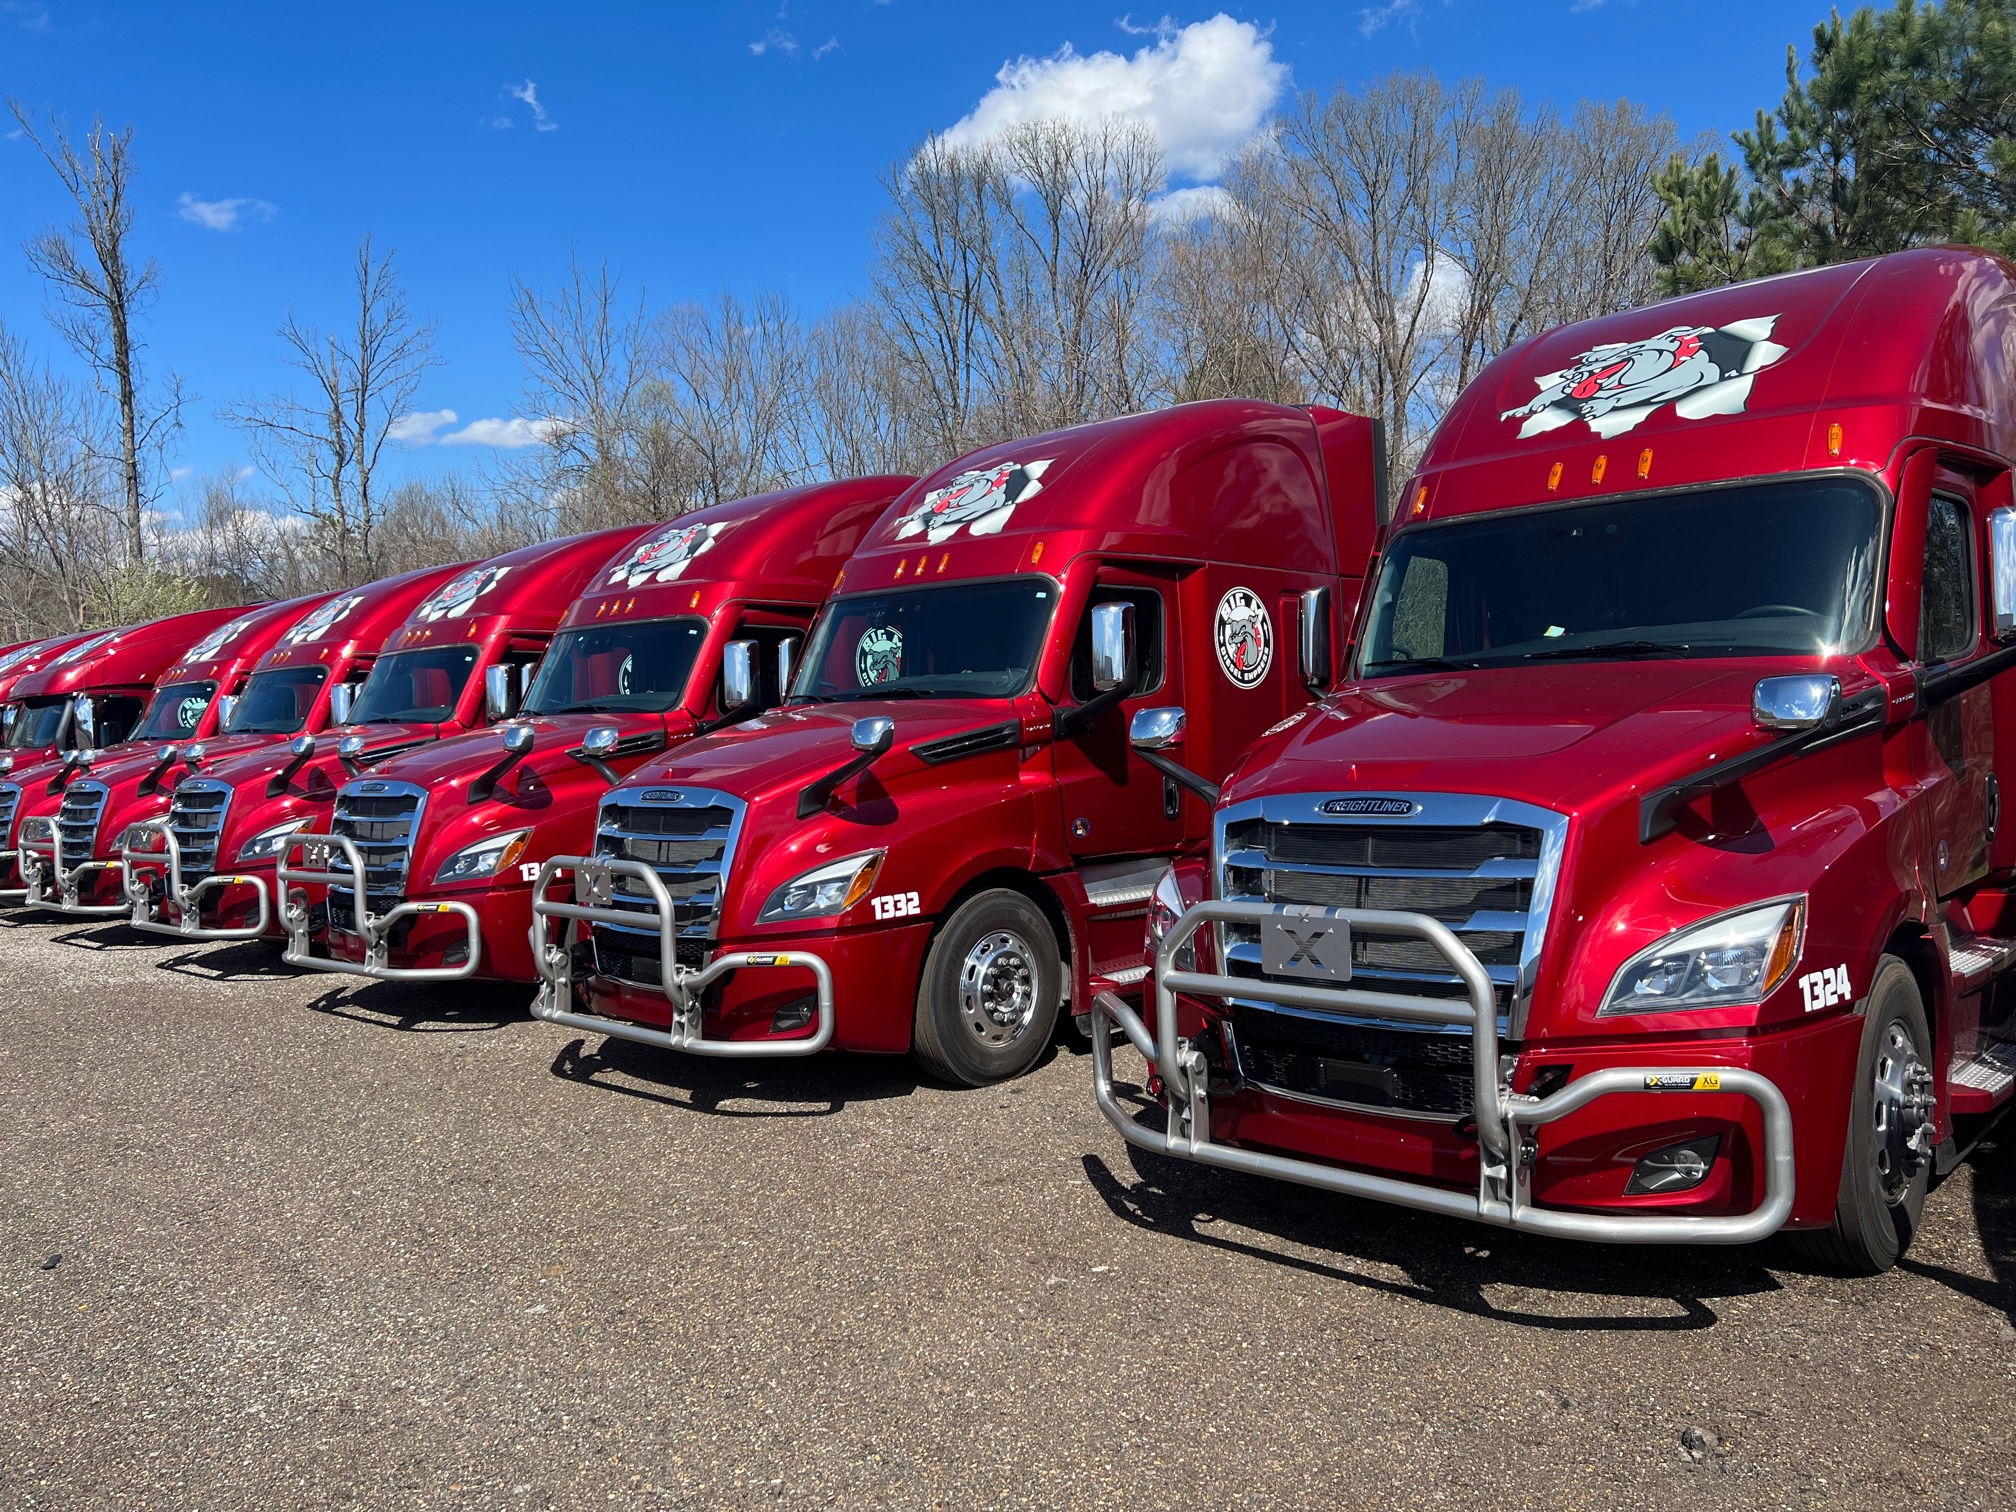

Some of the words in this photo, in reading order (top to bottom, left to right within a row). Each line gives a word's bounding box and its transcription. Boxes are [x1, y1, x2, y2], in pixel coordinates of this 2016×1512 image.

[1221, 592, 1246, 622] BIG
[862, 629, 887, 653] BIG
[1220, 645, 1242, 680] DIESEL
[1326, 800, 1410, 812] FREIGHTLINER
[871, 891, 921, 920] 1332
[1798, 962, 1852, 1012] 1324
